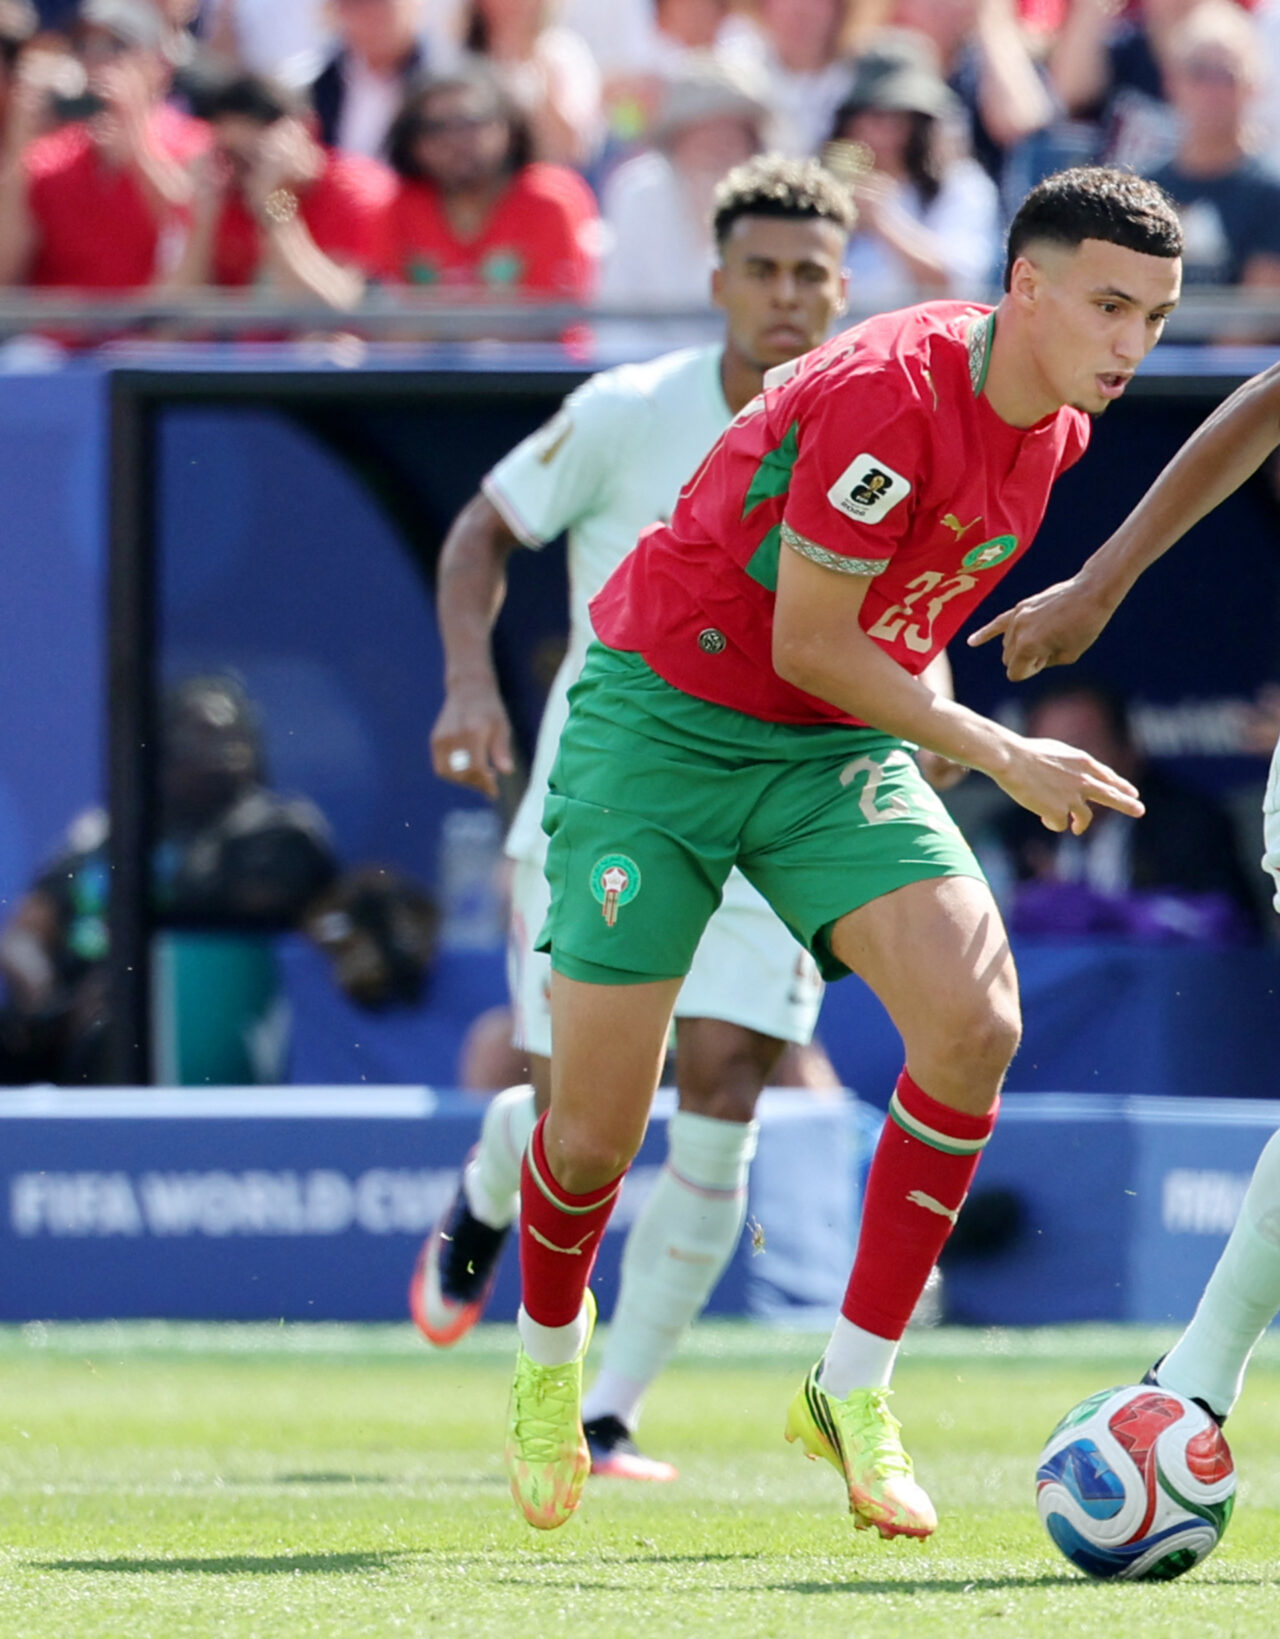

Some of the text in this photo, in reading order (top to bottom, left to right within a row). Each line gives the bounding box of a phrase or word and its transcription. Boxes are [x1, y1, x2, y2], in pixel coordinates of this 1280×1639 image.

[867, 571, 979, 654] 23
[839, 750, 916, 825] 2
[11, 1170, 144, 1238] FIFA
[141, 1168, 351, 1237] WORLD
